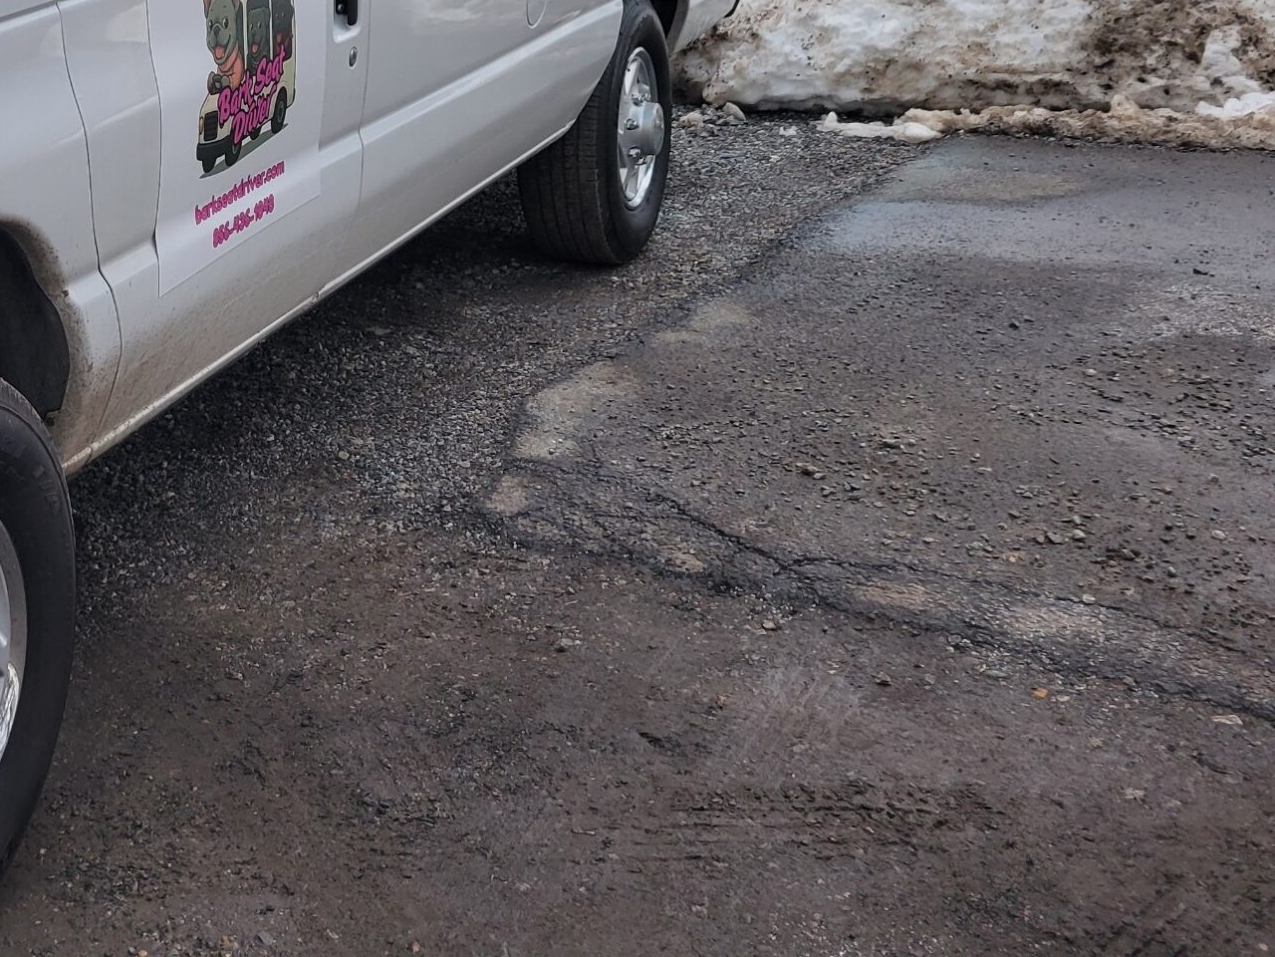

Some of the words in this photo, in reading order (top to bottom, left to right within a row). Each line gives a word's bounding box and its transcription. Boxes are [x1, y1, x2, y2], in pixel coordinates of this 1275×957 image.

[218, 69, 255, 129] Bark
[254, 44, 285, 95] Seat
[232, 83, 277, 146] Driver
[195, 161, 284, 225] barkseatdriver.com
